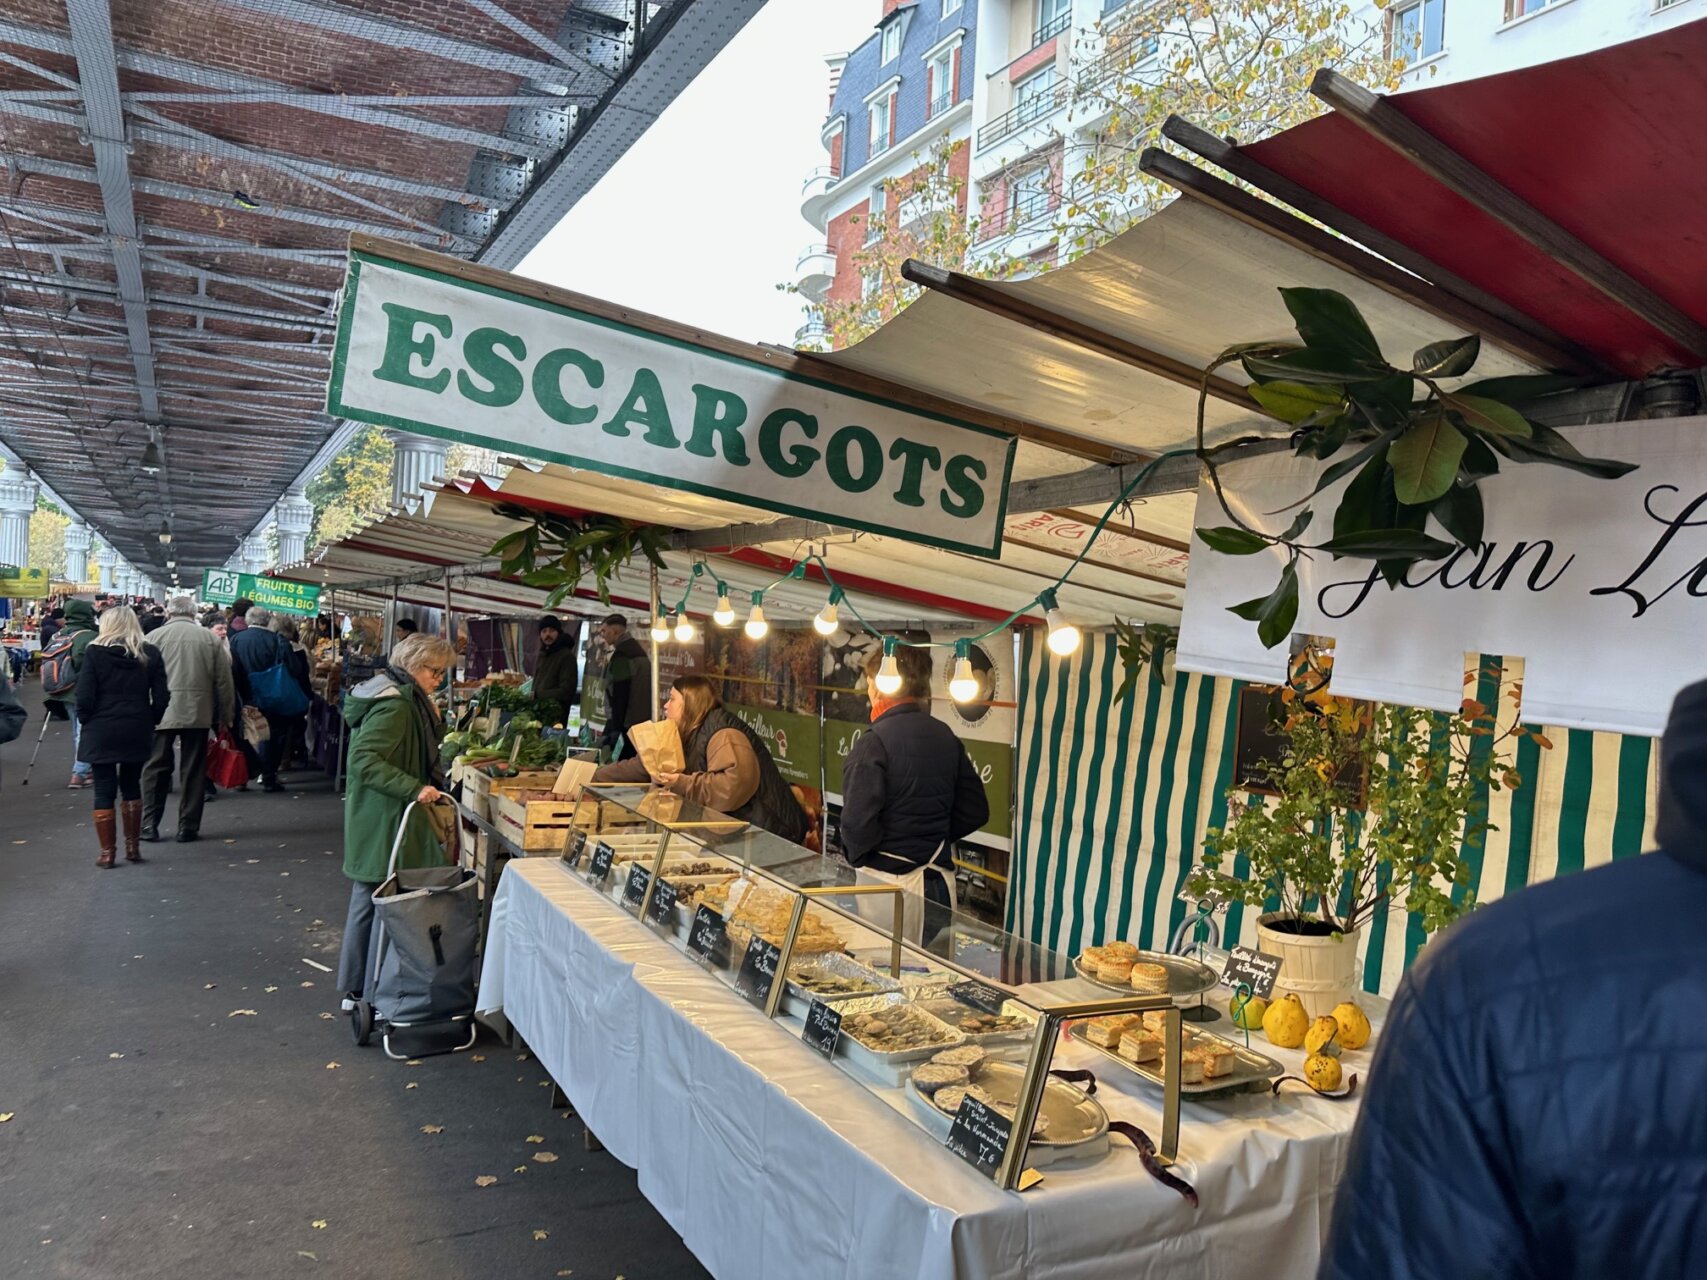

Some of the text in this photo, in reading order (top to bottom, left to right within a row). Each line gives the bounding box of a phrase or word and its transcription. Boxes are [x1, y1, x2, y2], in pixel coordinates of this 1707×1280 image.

[372, 302, 987, 519] ESCARGOTS
[208, 577, 234, 593] AB
[256, 578, 304, 595] FRUITS &
[295, 599, 314, 611] BIO
